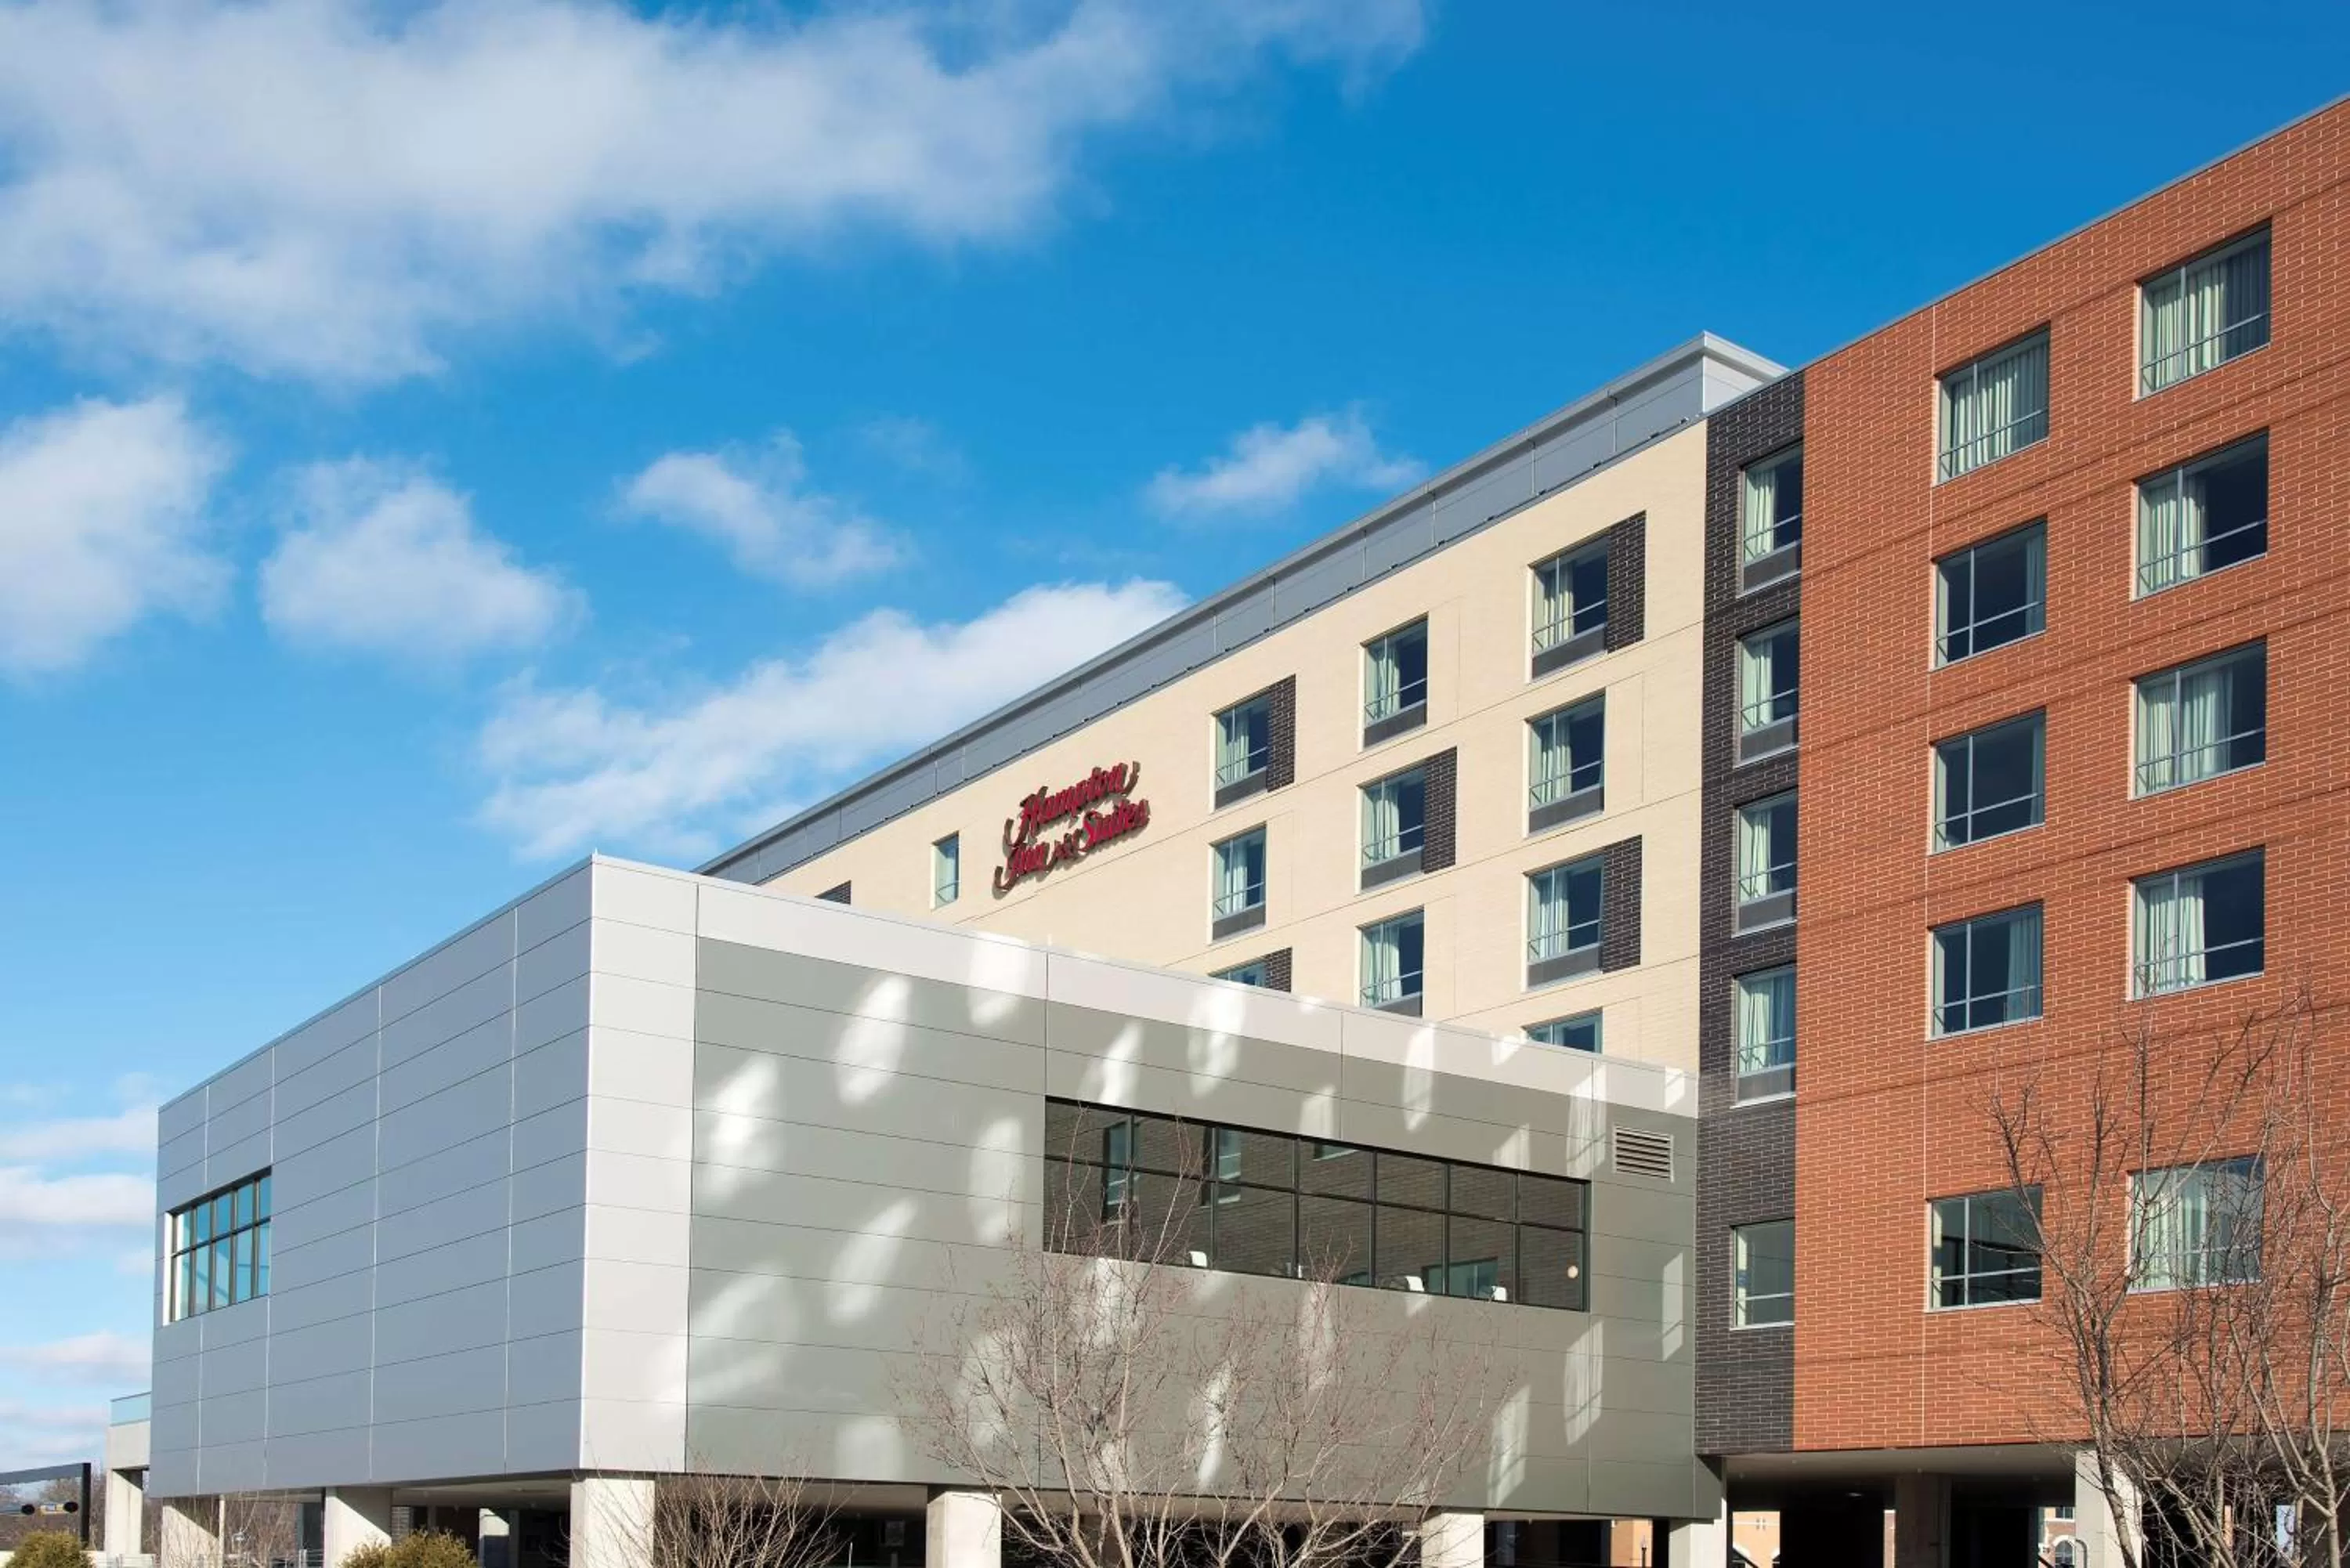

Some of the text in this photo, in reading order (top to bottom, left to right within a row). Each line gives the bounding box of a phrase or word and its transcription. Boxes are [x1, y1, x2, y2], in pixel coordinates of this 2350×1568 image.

[995, 842, 1056, 890] Inn
[1073, 799, 1150, 852] Suites
[1004, 761, 1141, 846] Hampton
